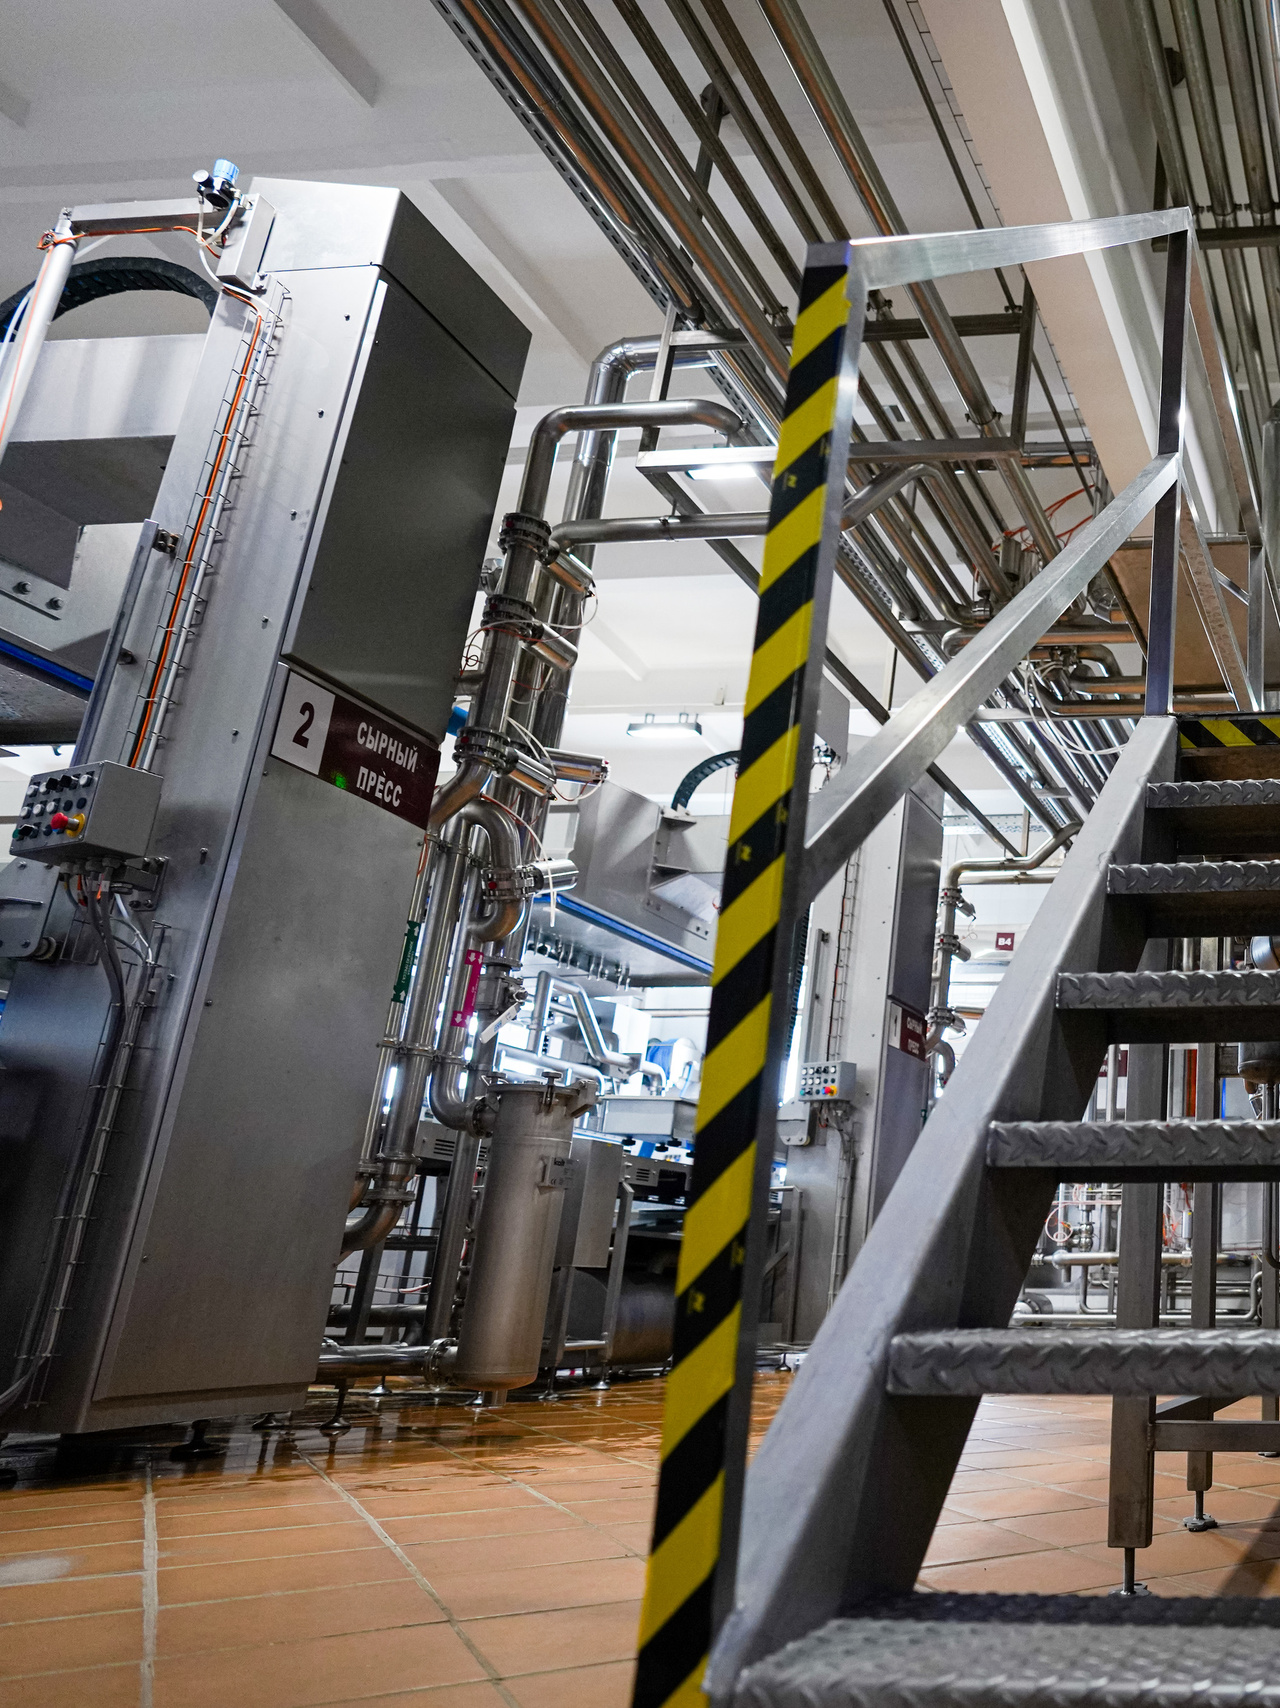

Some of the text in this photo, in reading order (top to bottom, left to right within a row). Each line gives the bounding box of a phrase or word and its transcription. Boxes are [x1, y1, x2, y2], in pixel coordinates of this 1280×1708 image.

[292, 701, 315, 749] 2
[357, 722, 419, 773] СЫРНЫЙ
[356, 766, 403, 807] ПРЕСС
